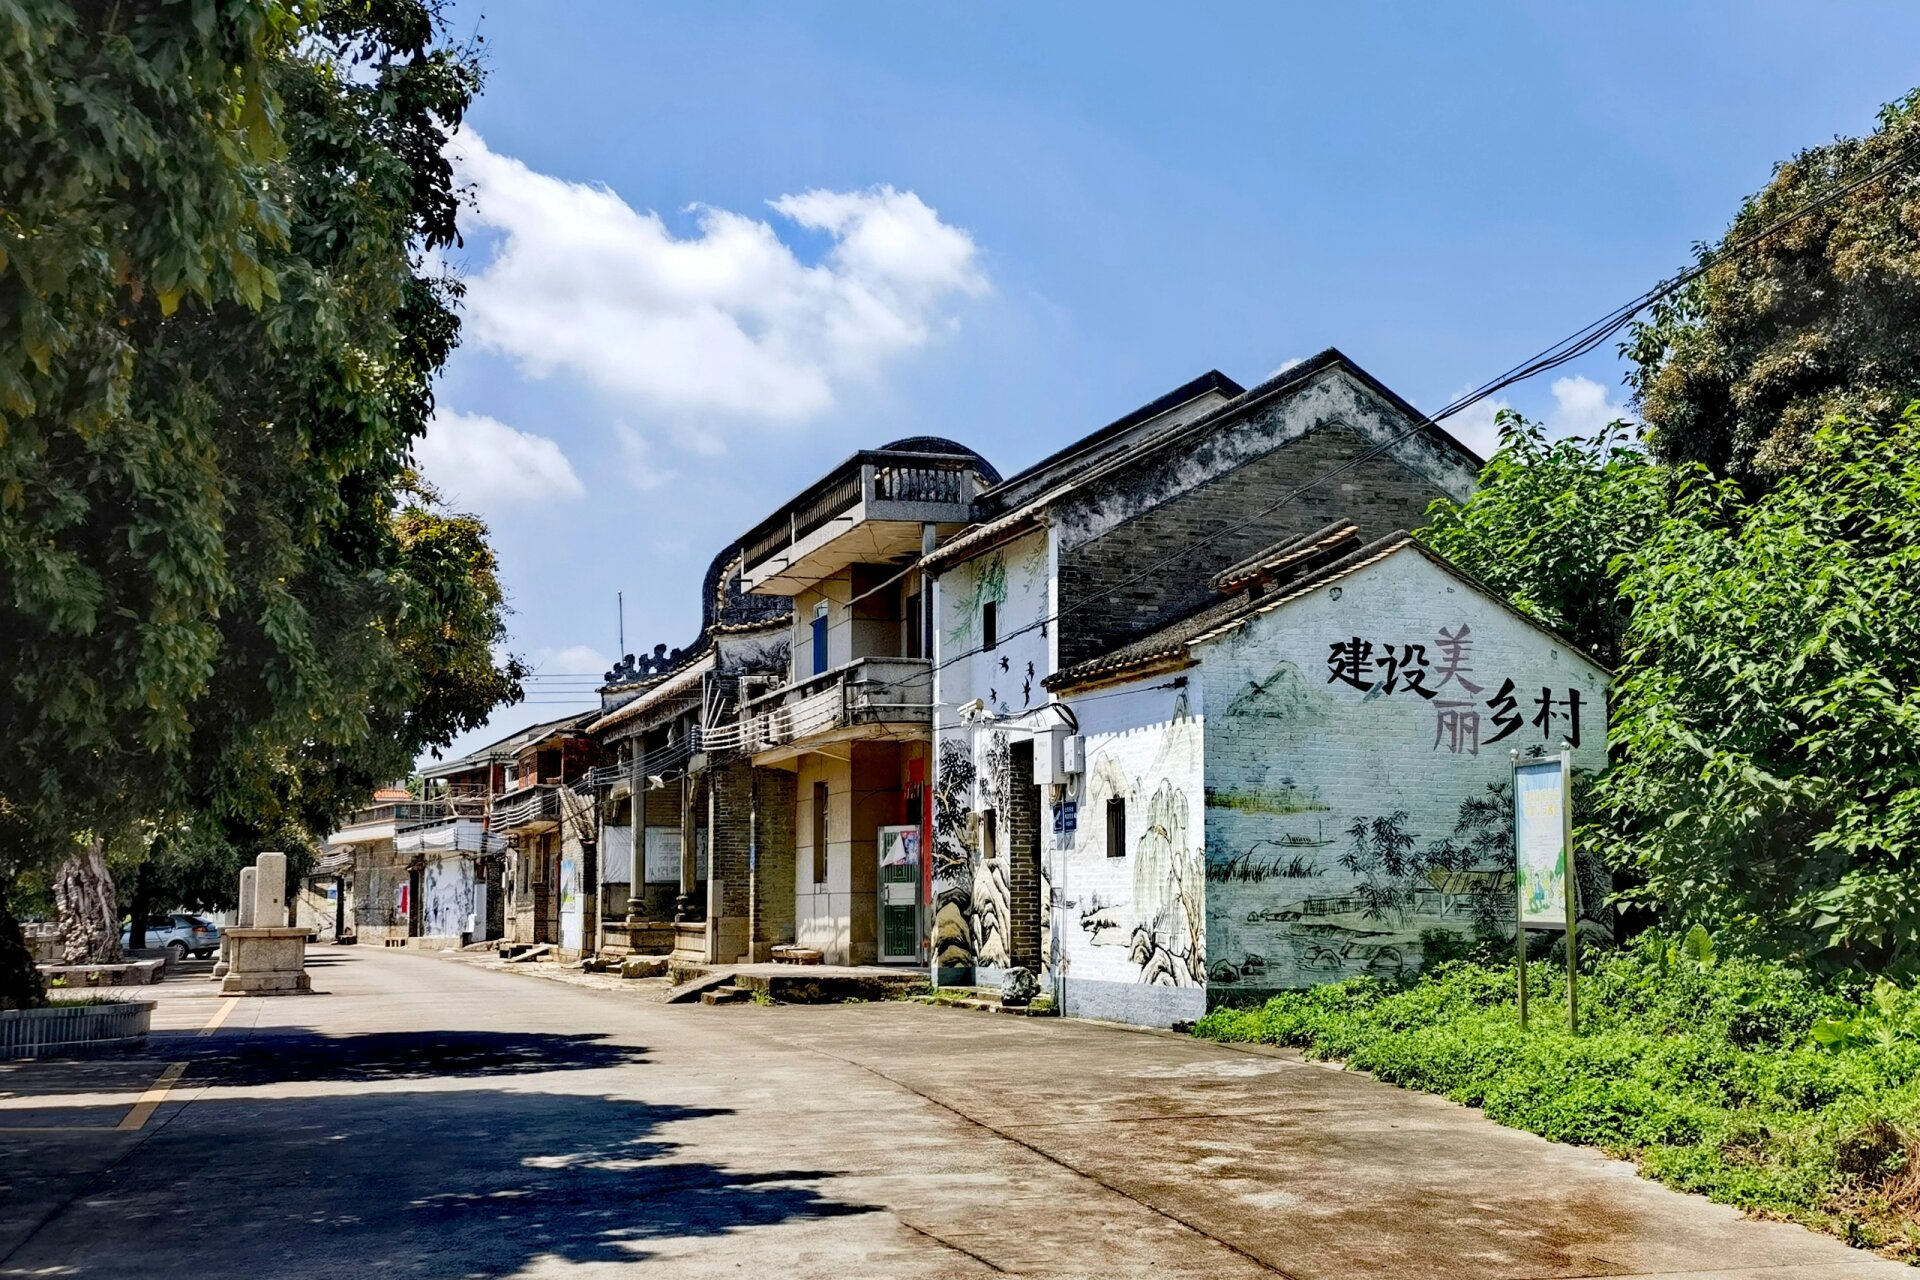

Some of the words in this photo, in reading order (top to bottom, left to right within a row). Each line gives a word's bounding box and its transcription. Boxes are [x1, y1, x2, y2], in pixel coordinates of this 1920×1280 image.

[1327, 637, 1437, 699] 建设
[1432, 623, 1484, 756] 美丽
[1481, 678, 1587, 748] 乡村
